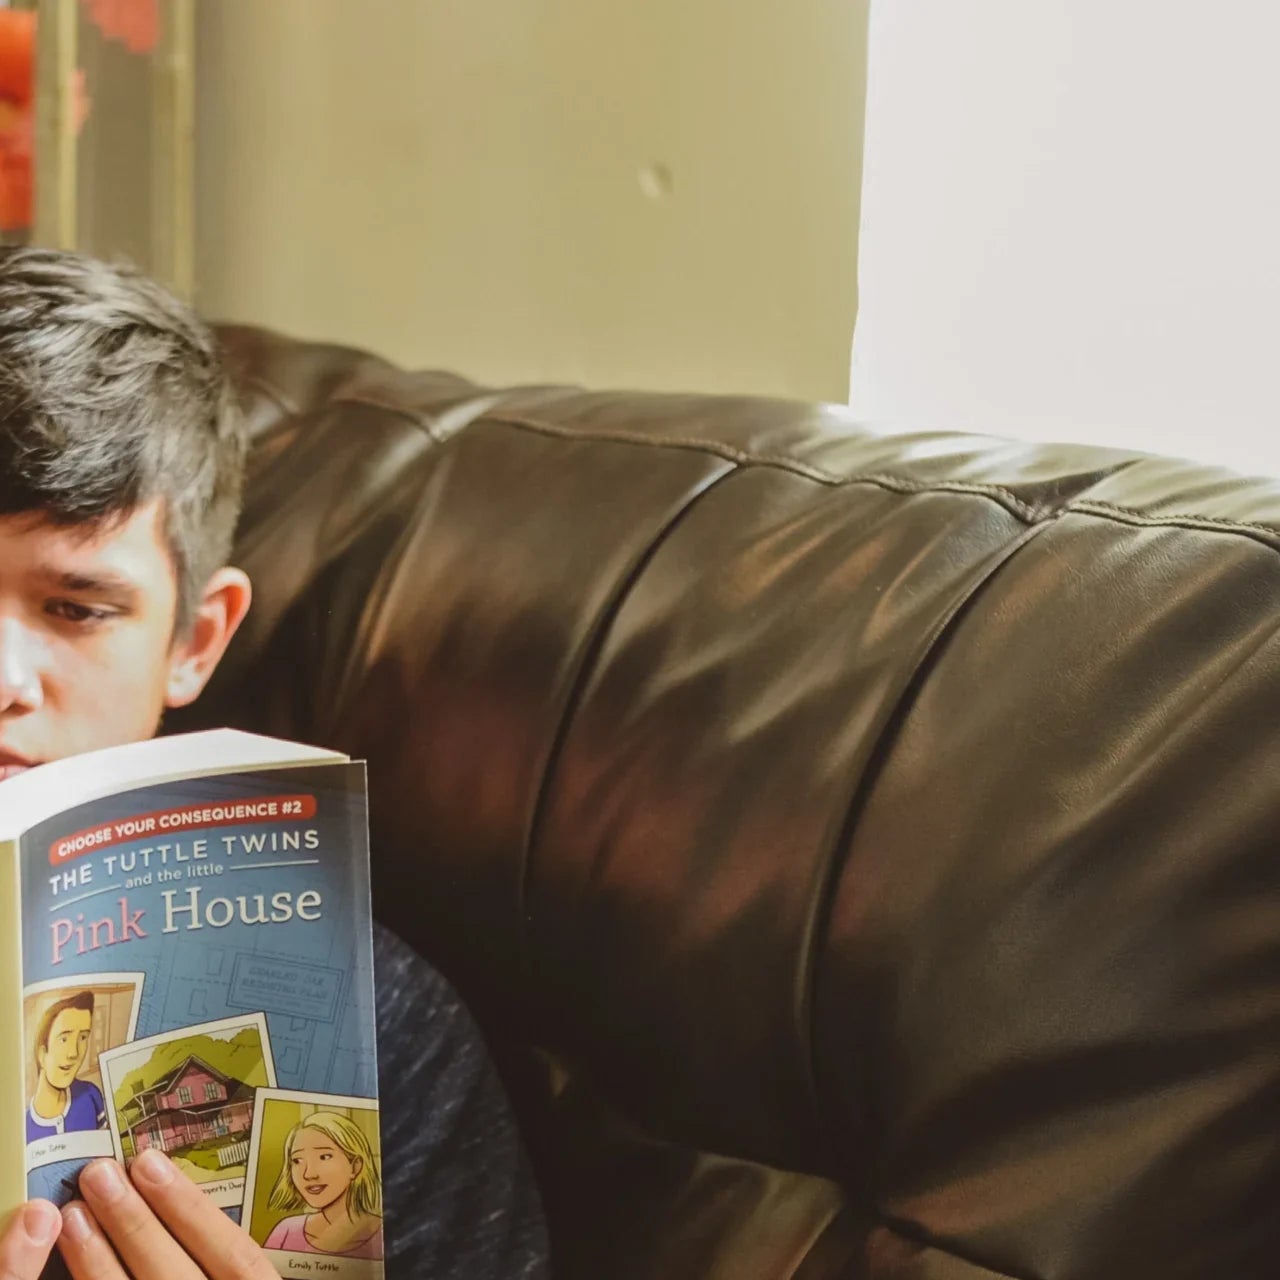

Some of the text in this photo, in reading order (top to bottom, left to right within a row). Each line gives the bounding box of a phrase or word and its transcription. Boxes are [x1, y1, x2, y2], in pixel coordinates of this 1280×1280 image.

[58, 801, 302, 857] CHOOSE YOUR CONSEQUENCE #2
[49, 829, 320, 895] THE TUTTLE TWINS
[125, 864, 223, 889] and the little
[50, 885, 321, 966] Pink House
[289, 1259, 339, 1271] Emily Tuttle
